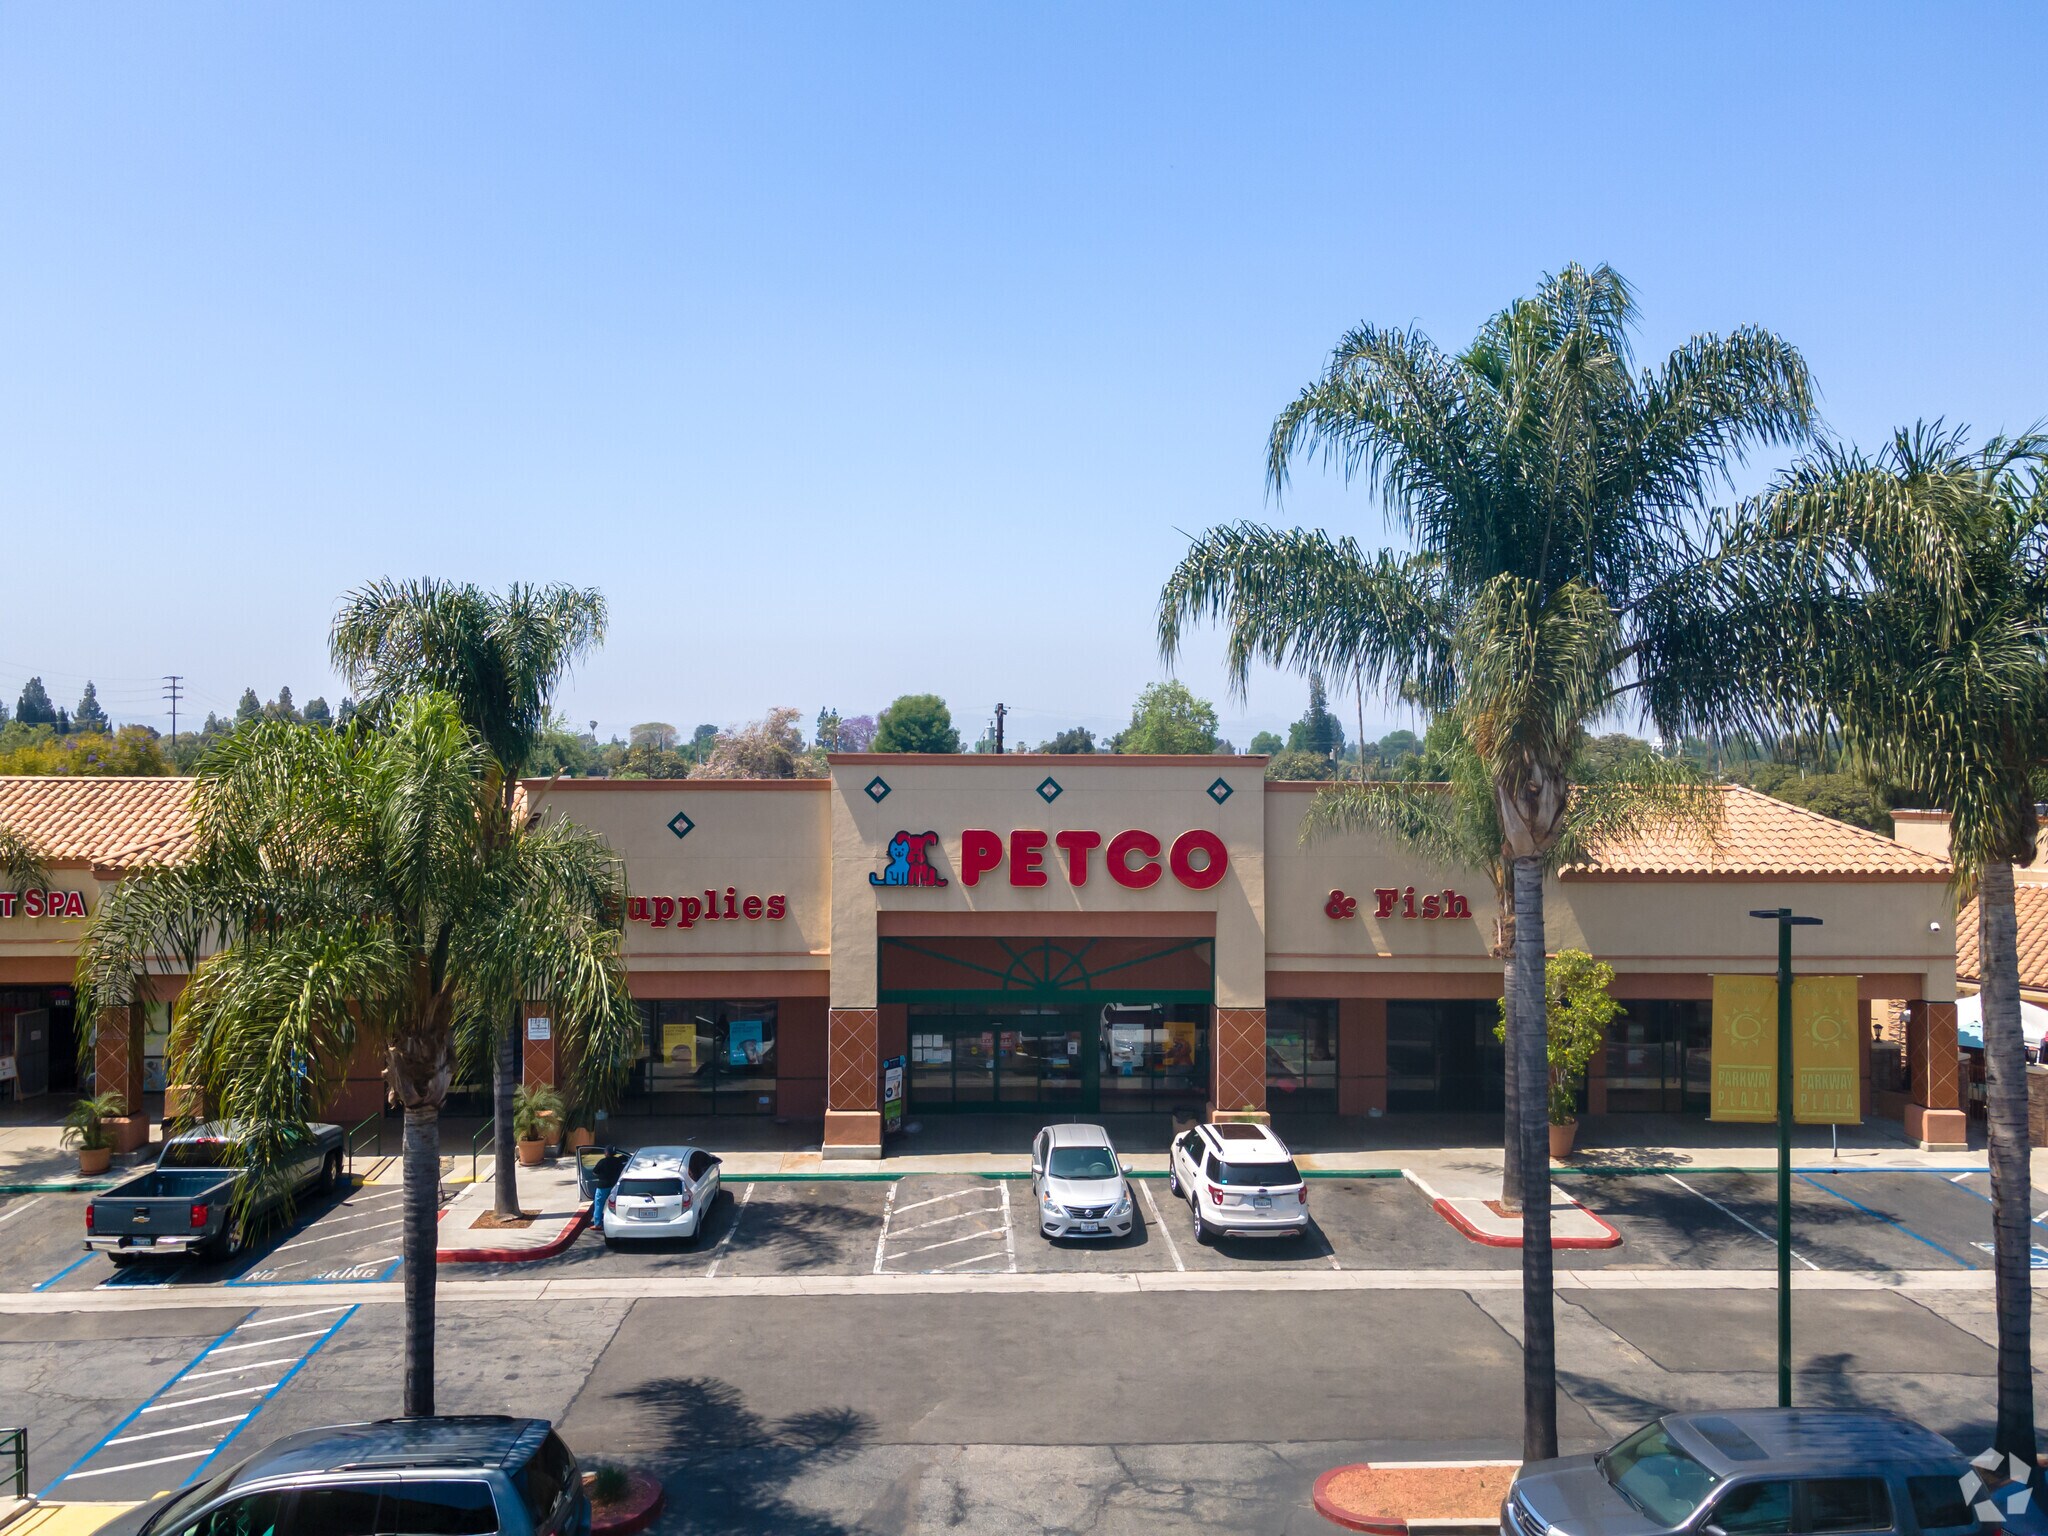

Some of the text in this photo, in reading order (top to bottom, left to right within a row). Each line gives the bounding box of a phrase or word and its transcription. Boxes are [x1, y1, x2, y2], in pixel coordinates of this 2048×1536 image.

[960, 828, 1229, 890] PETCO
[0, 888, 87, 918] T SPA
[1324, 886, 1473, 920] & Fish
[1718, 1071, 1771, 1089] PARKWAY
[1800, 1073, 1853, 1091] PARKWAY
[1717, 1090, 1771, 1108] PLAZA
[1800, 1093, 1854, 1110] PLAZA
[245, 1269, 279, 1281] NO
